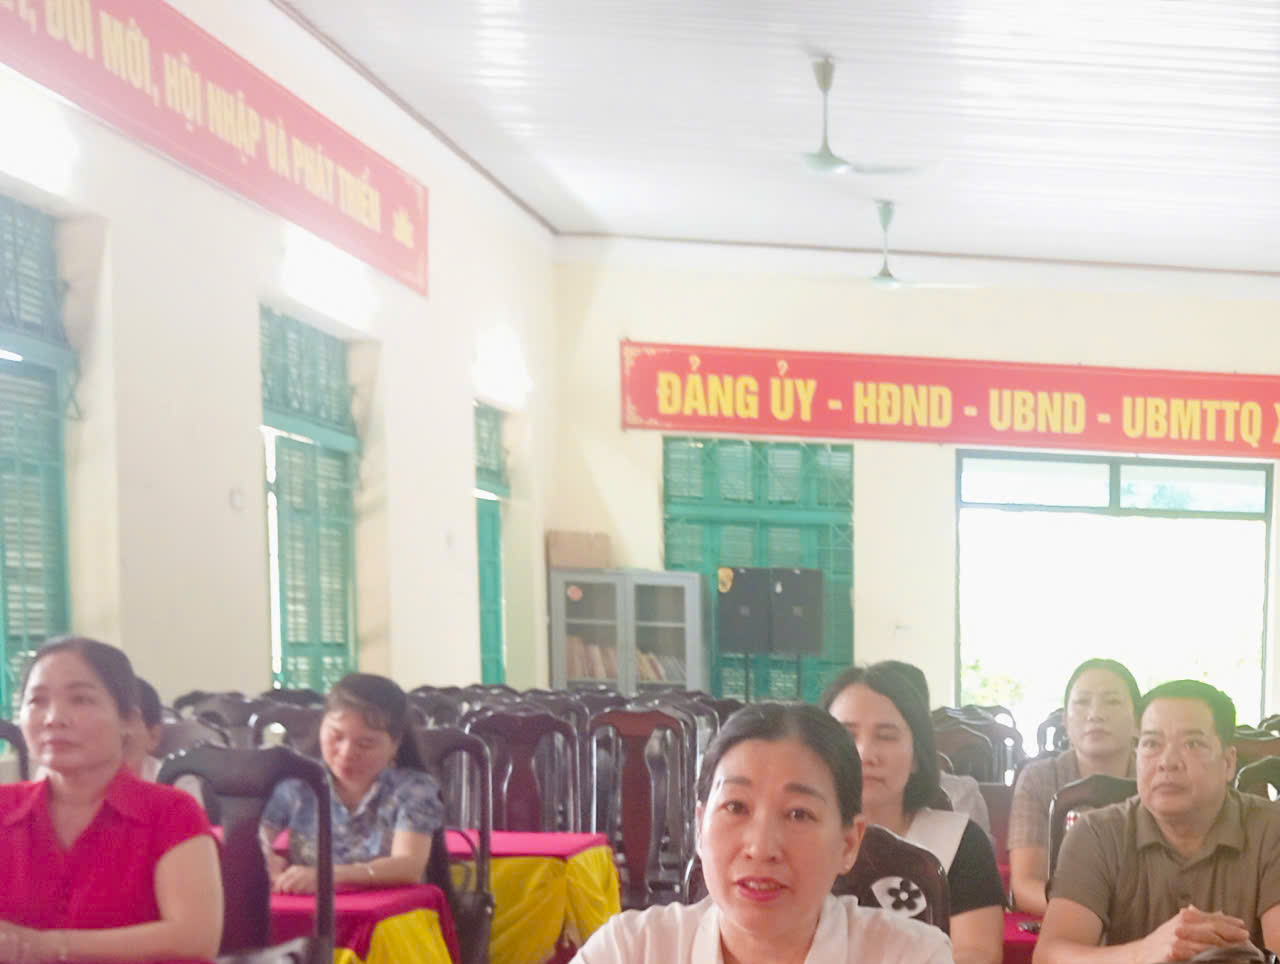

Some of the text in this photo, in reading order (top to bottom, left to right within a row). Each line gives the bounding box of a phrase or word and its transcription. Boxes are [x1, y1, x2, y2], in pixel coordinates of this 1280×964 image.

[656, 355, 759, 420] ĐẢNG
[770, 360, 817, 422] ỦY
[853, 381, 952, 428] HĐND
[988, 389, 1087, 435] UBND
[1122, 396, 1262, 448] UBMTTQ
